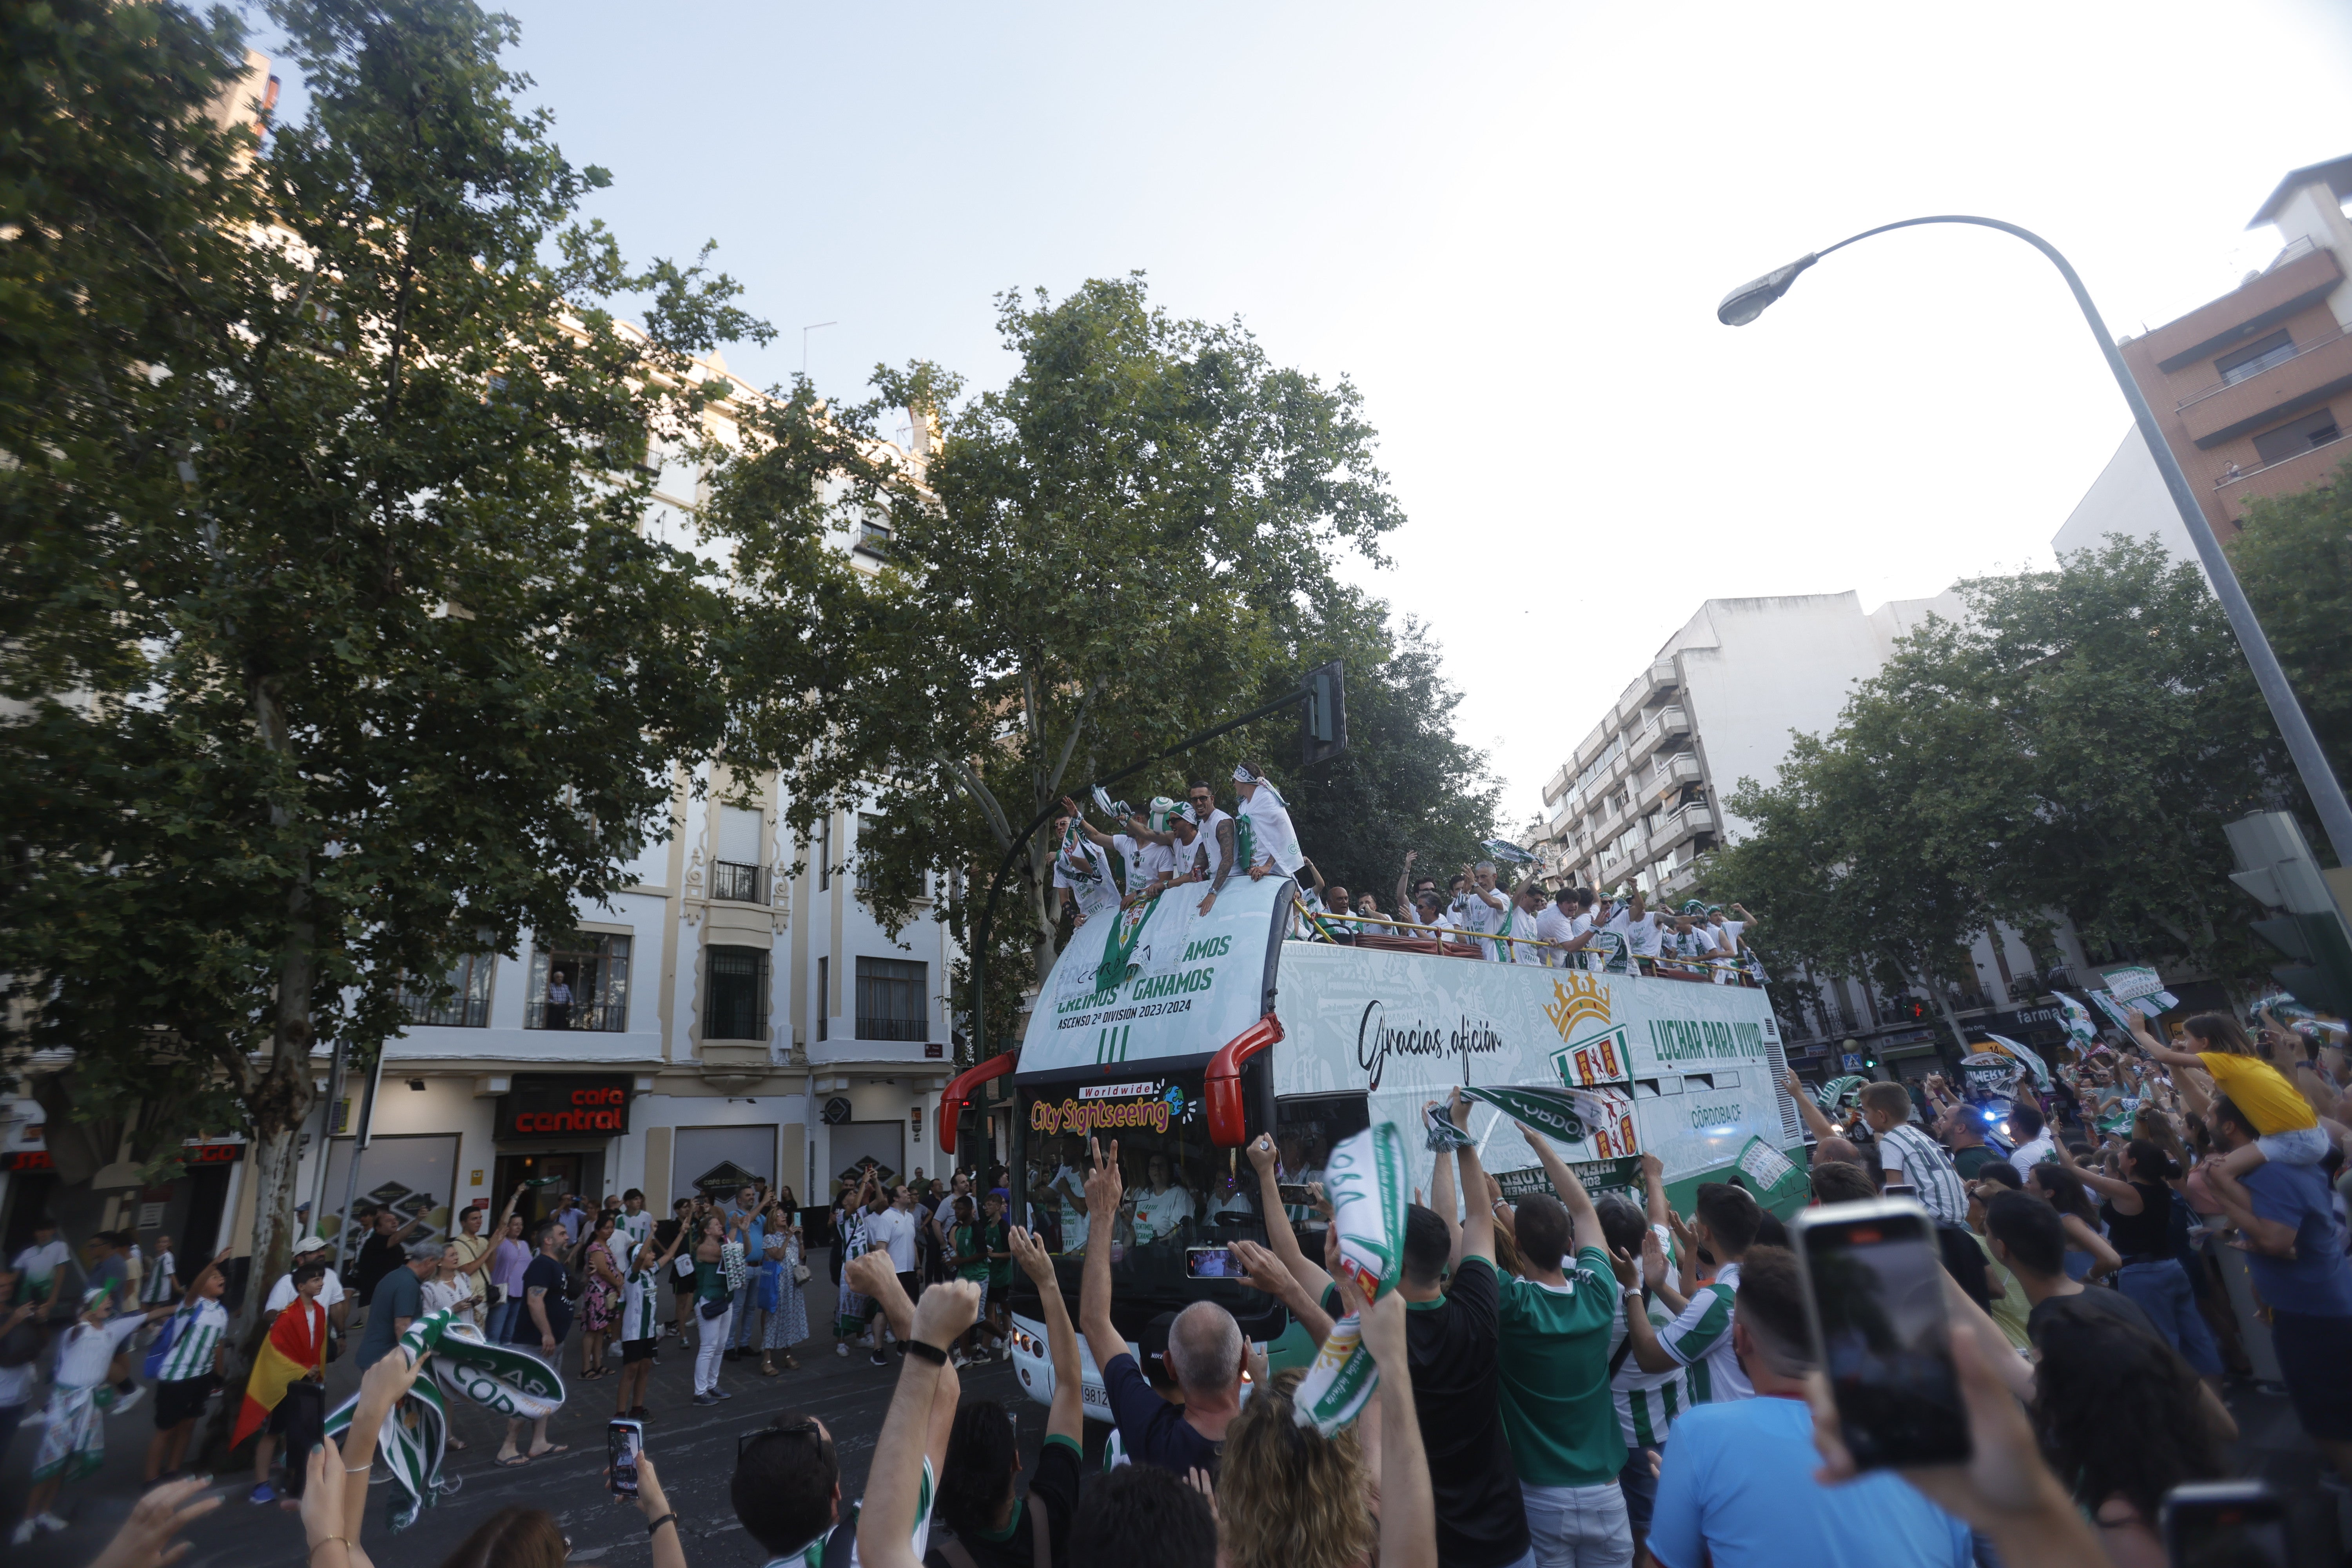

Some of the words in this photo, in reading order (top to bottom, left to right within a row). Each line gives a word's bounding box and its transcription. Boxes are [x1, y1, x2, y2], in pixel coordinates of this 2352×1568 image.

[1181, 935, 1232, 962] AMOS
[1132, 967, 1214, 1001] GANAMOS
[1057, 1014, 1091, 1030] ASCENSO
[1102, 1005, 1138, 1023] DIVISIÓN
[1138, 999, 1192, 1018] 2023/2024
[1648, 1020, 1706, 1060] LUCHAR
[1701, 1021, 1737, 1058] PARA
[1733, 1022, 1766, 1057] VIVIR
[571, 1086, 624, 1105] café
[1085, 1084, 1150, 1097] Worldwide
[515, 1108, 622, 1132] central
[1031, 1100, 1062, 1135] City
[1062, 1097, 1169, 1136] Sightseeing
[1731, 1104, 1741, 1122] CF
[1085, 1388, 1108, 1405] 9812
